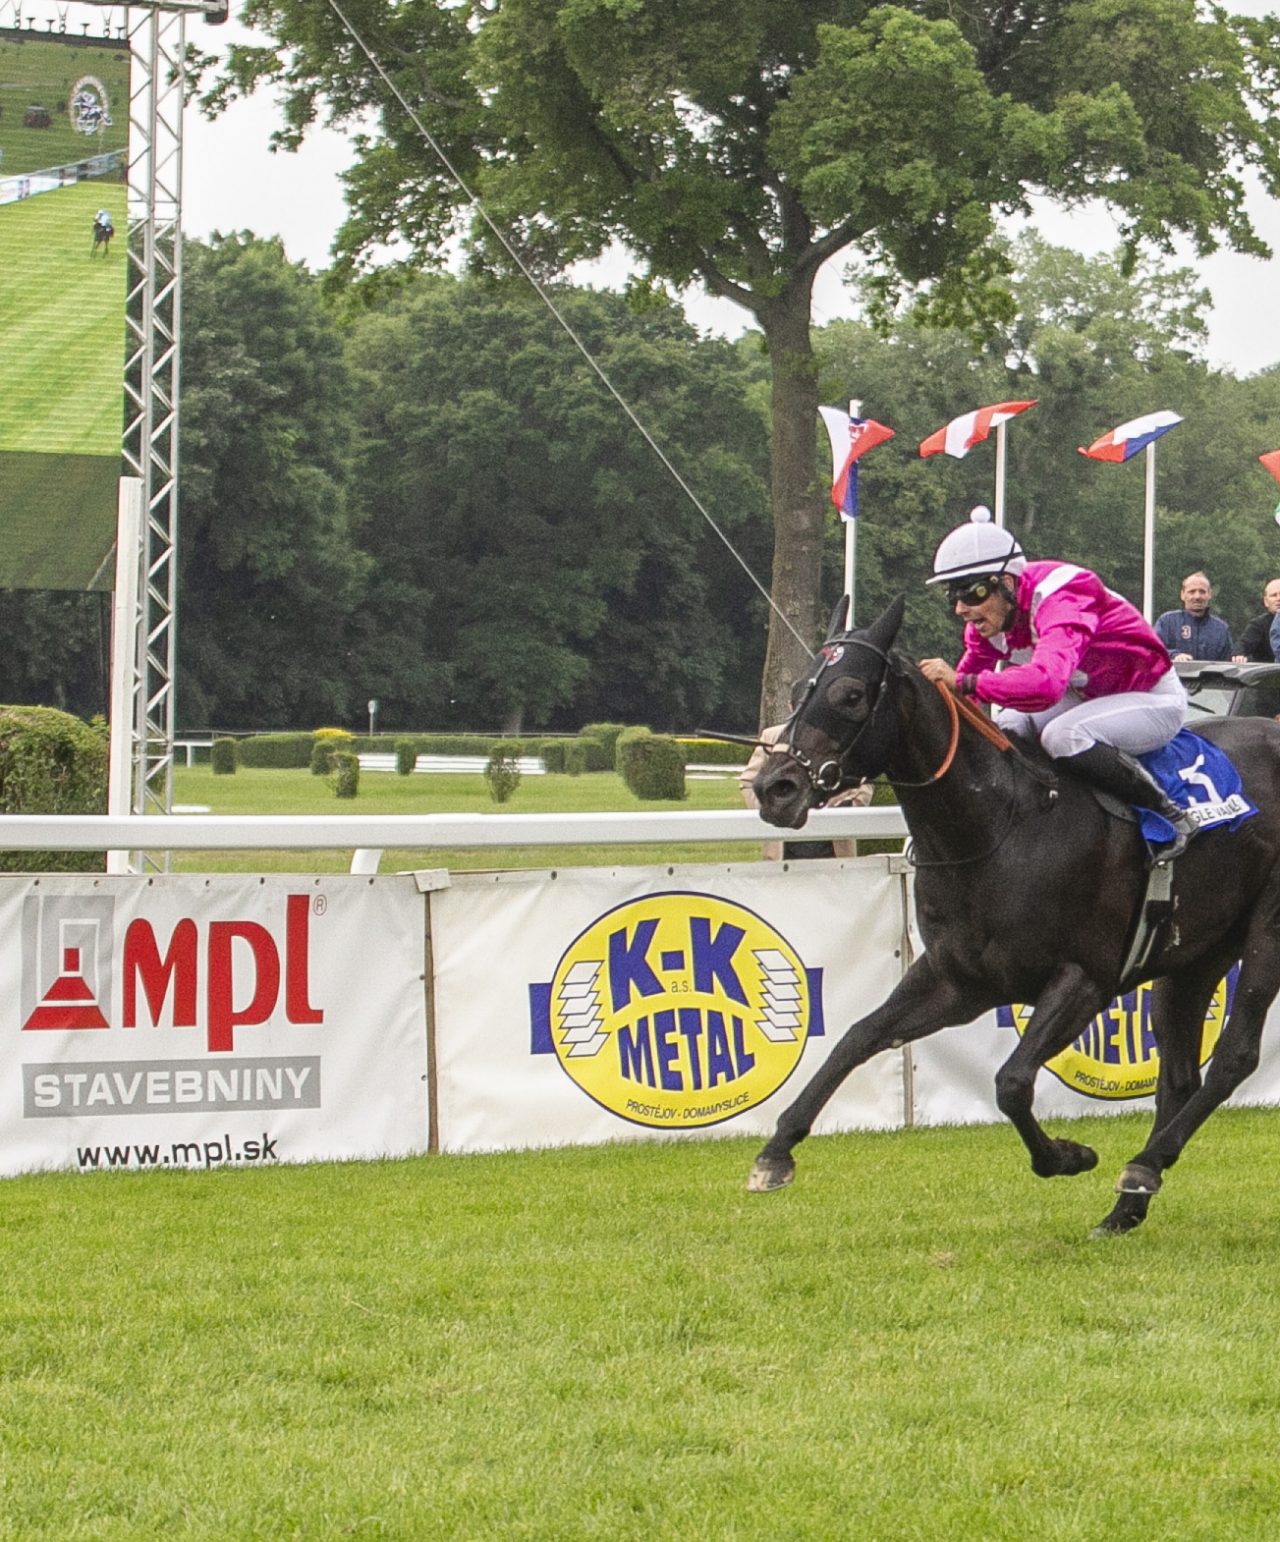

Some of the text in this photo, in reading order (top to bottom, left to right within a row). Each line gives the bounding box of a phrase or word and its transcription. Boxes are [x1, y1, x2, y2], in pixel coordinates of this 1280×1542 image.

[608, 916, 750, 1014] K-K
[671, 978, 692, 993] a.s.
[617, 1008, 755, 1092] METAL
[34, 1067, 311, 1107] STAVEBNINY
[682, 1091, 750, 1120] DOMAMYSLICE
[77, 1133, 279, 1170] www.mpl.sk
